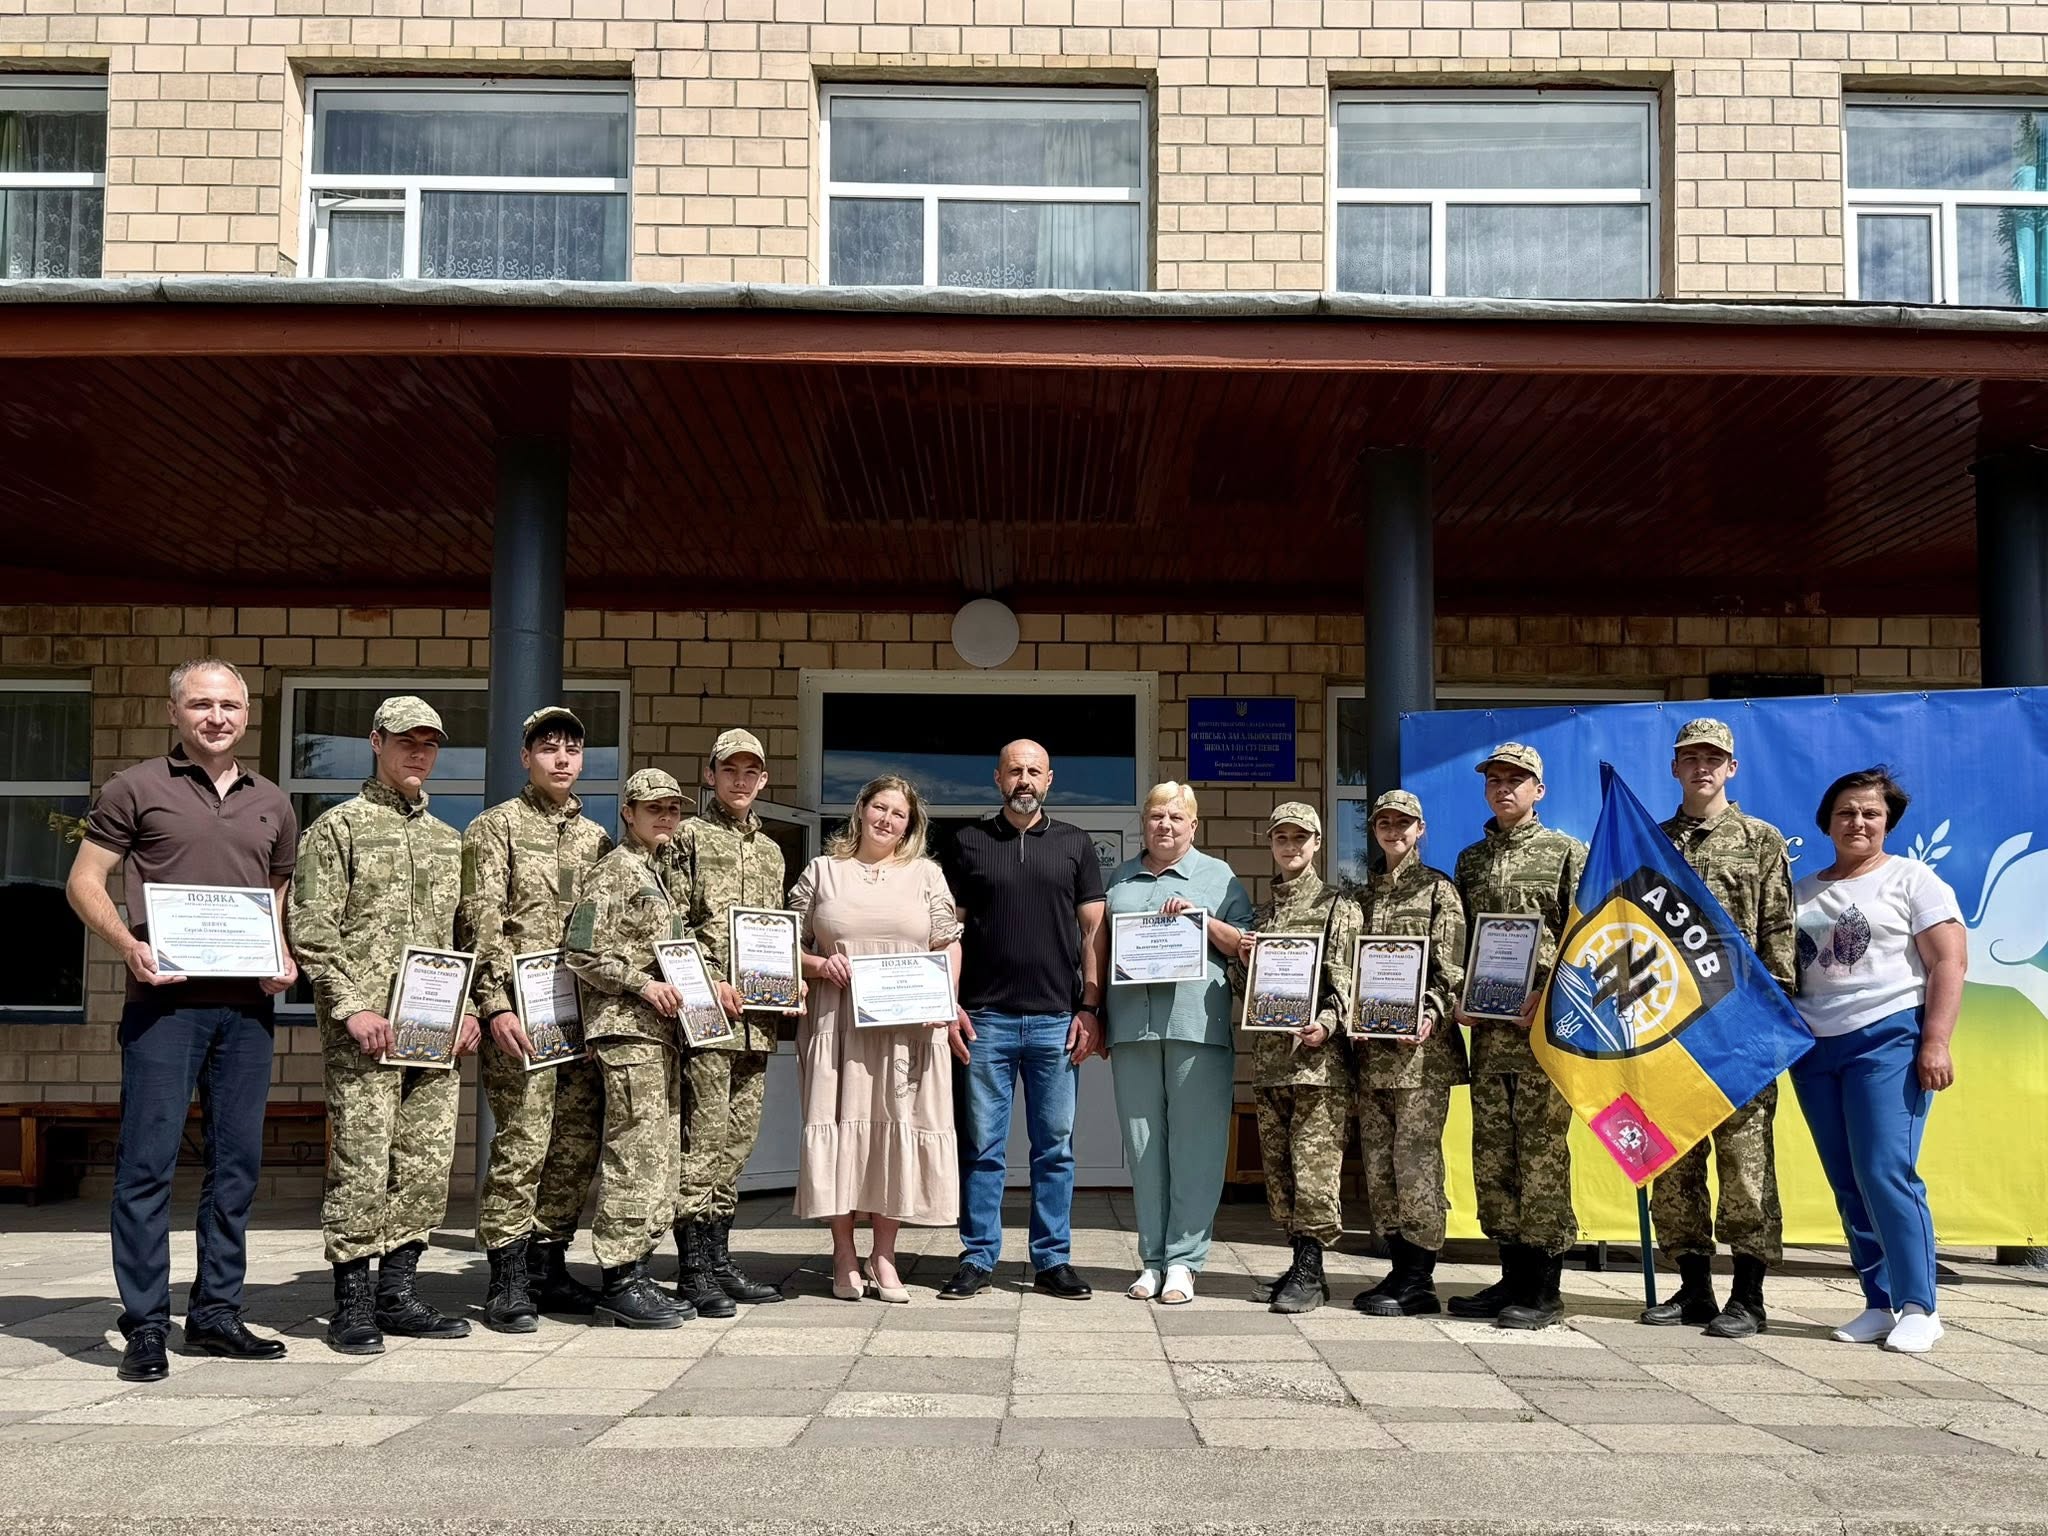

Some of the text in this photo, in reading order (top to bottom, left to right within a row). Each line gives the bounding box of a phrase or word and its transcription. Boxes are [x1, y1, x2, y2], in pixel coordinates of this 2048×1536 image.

[1204, 744, 1230, 752] ШКОЛА
[187, 893, 235, 903] ПОДЯКА
[1142, 916, 1177, 925] ПОДЯКА
[1641, 885, 1720, 978] АЗОВ
[882, 959, 919, 967] ПОДЯКА
